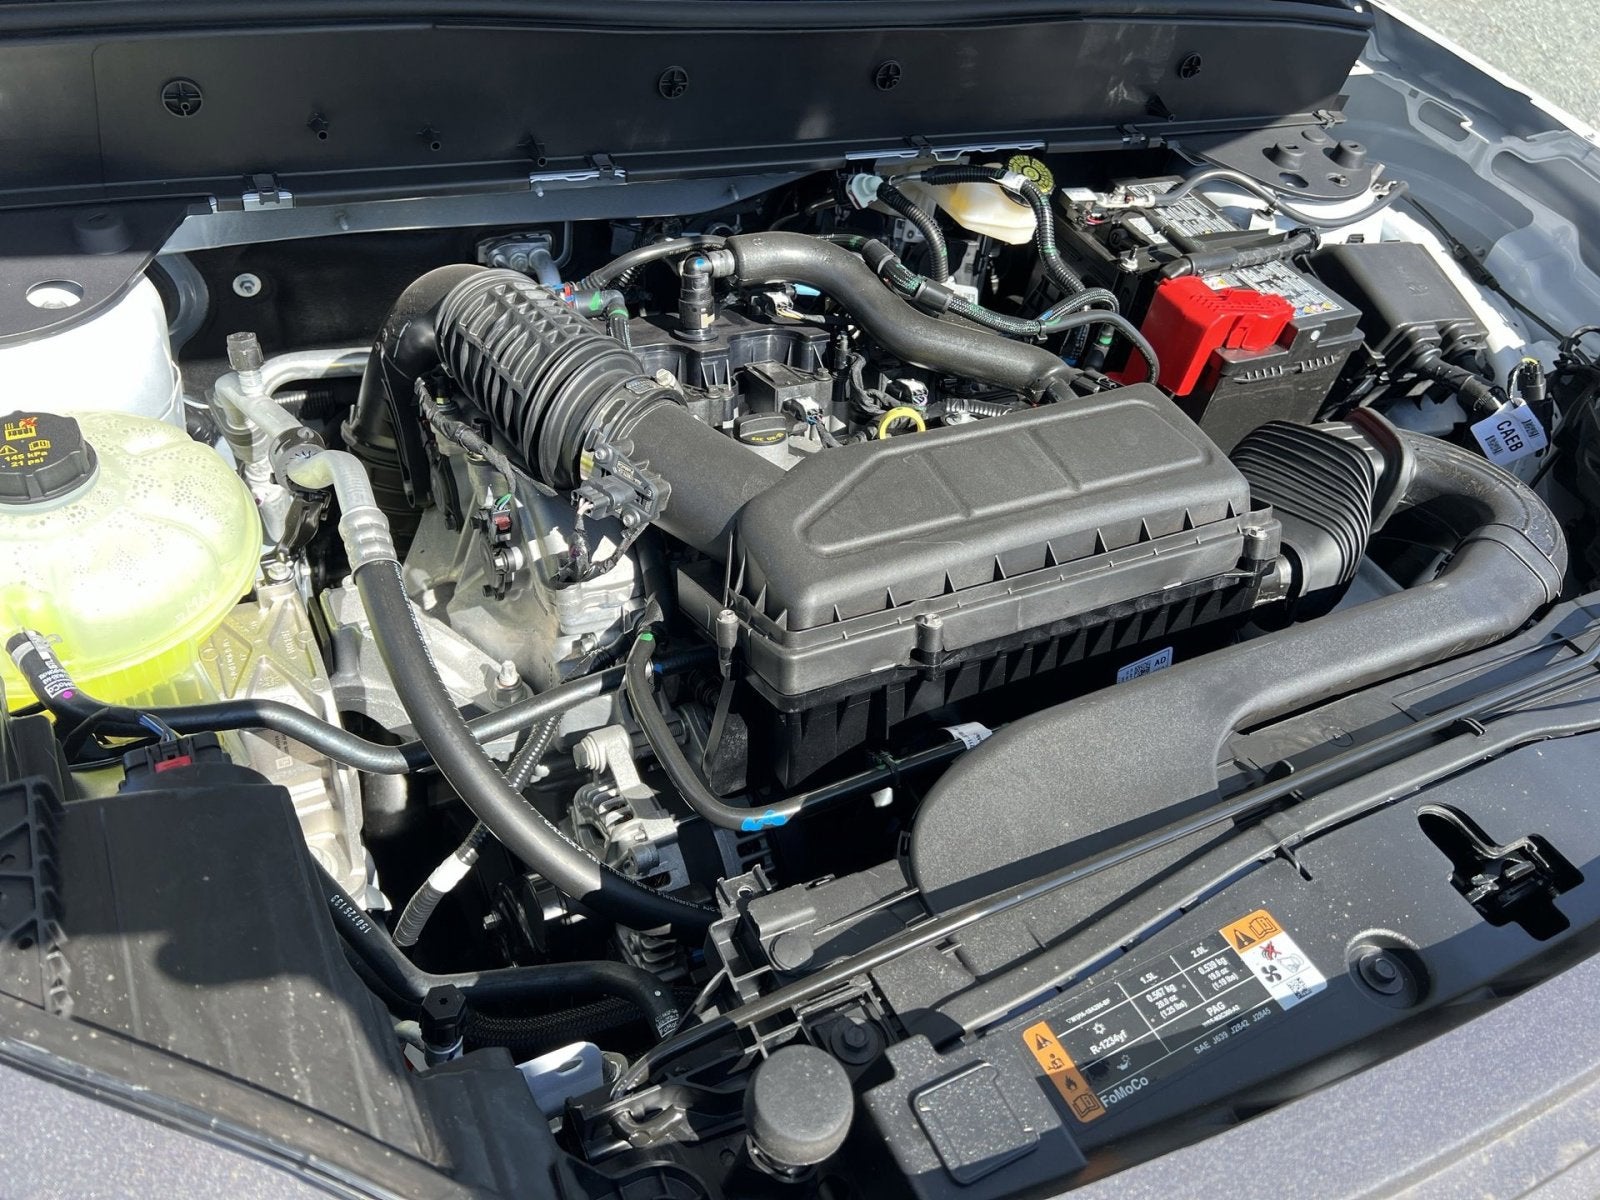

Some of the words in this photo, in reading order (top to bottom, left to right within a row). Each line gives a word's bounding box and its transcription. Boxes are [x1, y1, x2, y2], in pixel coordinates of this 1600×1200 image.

[1496, 420, 1524, 452] CAEB
[4, 453, 25, 462] 145
[27, 451, 48, 459] kPa
[10, 460, 24, 468] 21
[27, 457, 44, 466] psi
[1190, 945, 1209, 959] 2.0L
[1214, 957, 1229, 966] kg
[1220, 967, 1230, 975] oz
[1140, 972, 1158, 984] 1.5L
[1224, 972, 1239, 983] lbs)
[1163, 983, 1178, 993] kg
[1169, 994, 1179, 1003] oz
[1160, 1005, 1176, 1019] (1.25
[1173, 999, 1188, 1011] lbs)
[1206, 1001, 1226, 1017] PAG
[1089, 1029, 1128, 1055] R-1234yf
[1193, 1041, 1212, 1055] SAE
[1212, 1031, 1229, 1045] J639
[1230, 1019, 1251, 1034] J2842
[1100, 1076, 1149, 1108] FoMoCo
